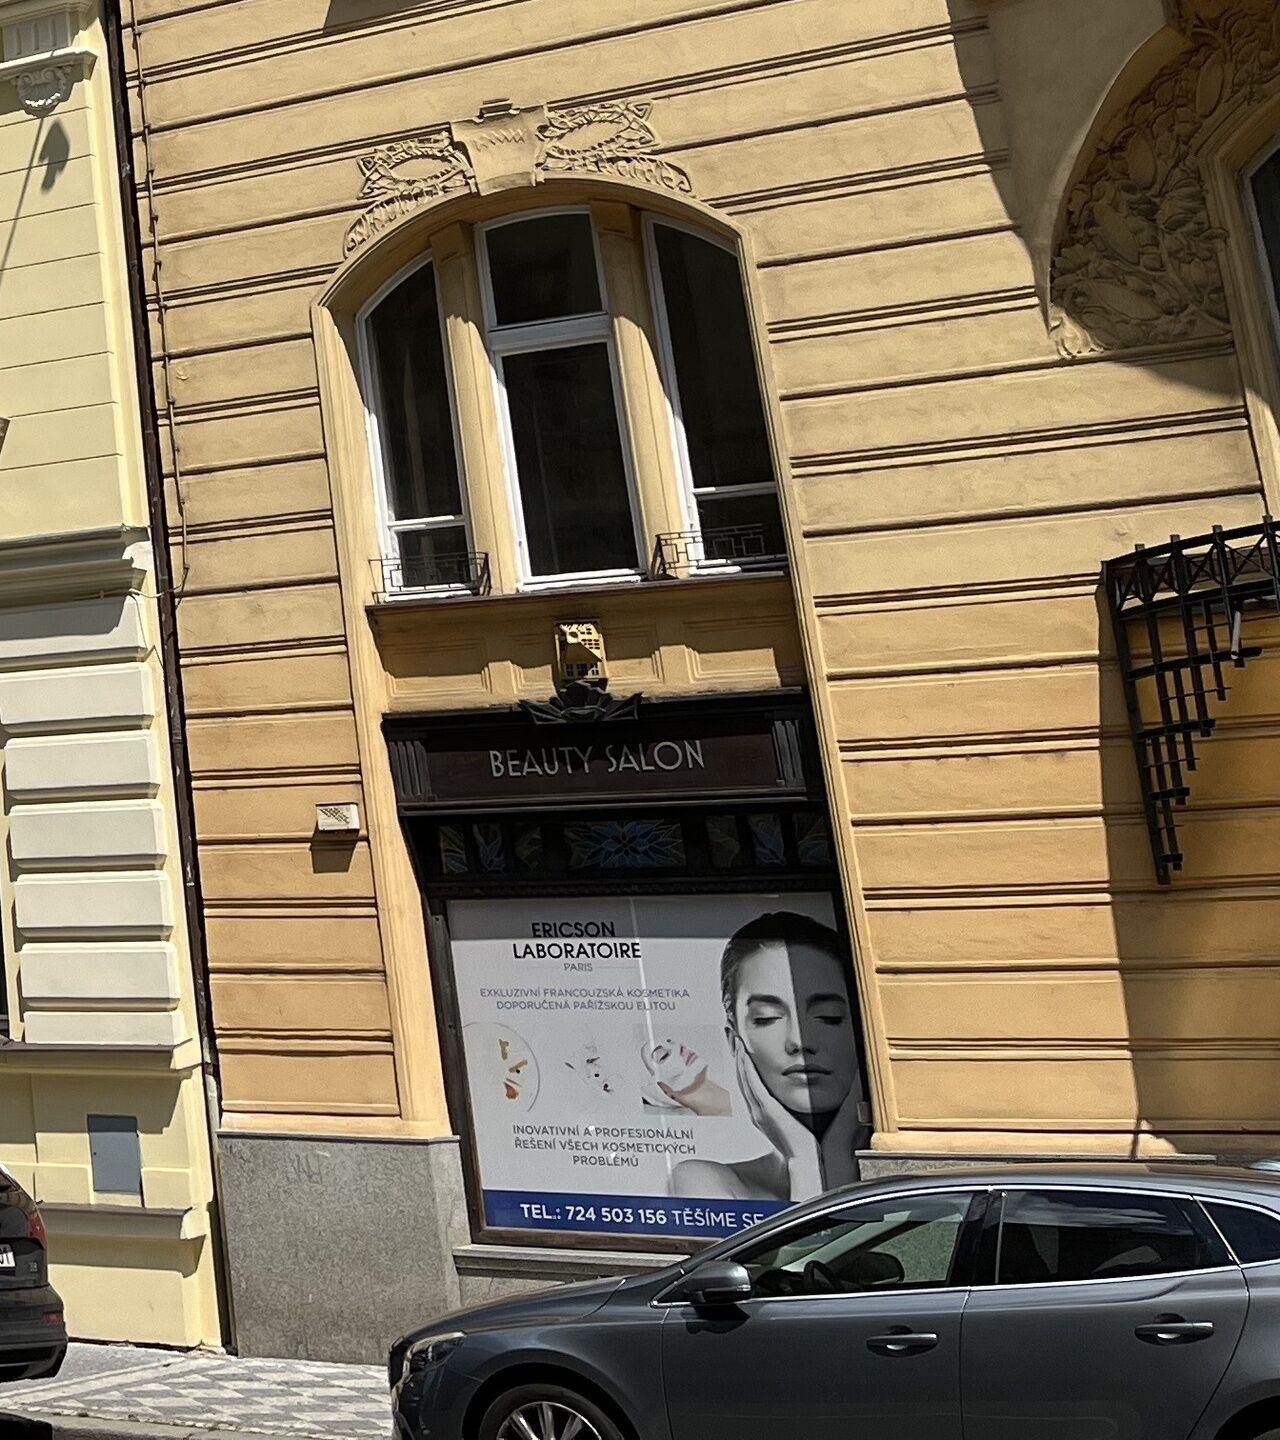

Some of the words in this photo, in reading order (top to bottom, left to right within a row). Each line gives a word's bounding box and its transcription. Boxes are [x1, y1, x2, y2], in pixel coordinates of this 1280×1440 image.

[489, 746, 592, 777] BEAUTY
[605, 740, 705, 772] SALON
[531, 921, 616, 938] ERICSON
[512, 942, 642, 959] LABORATOIRE
[563, 962, 593, 972] PARIS
[543, 986, 623, 998] FRANCOUZSKÁ
[627, 987, 690, 998] KOSMETIKA
[496, 999, 570, 1010] DOPORUČENÁ
[637, 1000, 676, 1011] ELITOU
[512, 1124, 580, 1136] INOVATIVNÍ
[583, 1126, 591, 1137] A
[595, 1125, 694, 1140] PROFESIONÁLNÍ
[514, 1137, 556, 1150] ŘEŠENÍ
[559, 1139, 599, 1152] VŠECH
[602, 1141, 696, 1155] KOSMETICKÝCH
[565, 1205, 596, 1222] 724
[601, 1207, 634, 1223] 503
[638, 1209, 667, 1225] 156
[671, 1207, 738, 1228] TĚŠÍME
